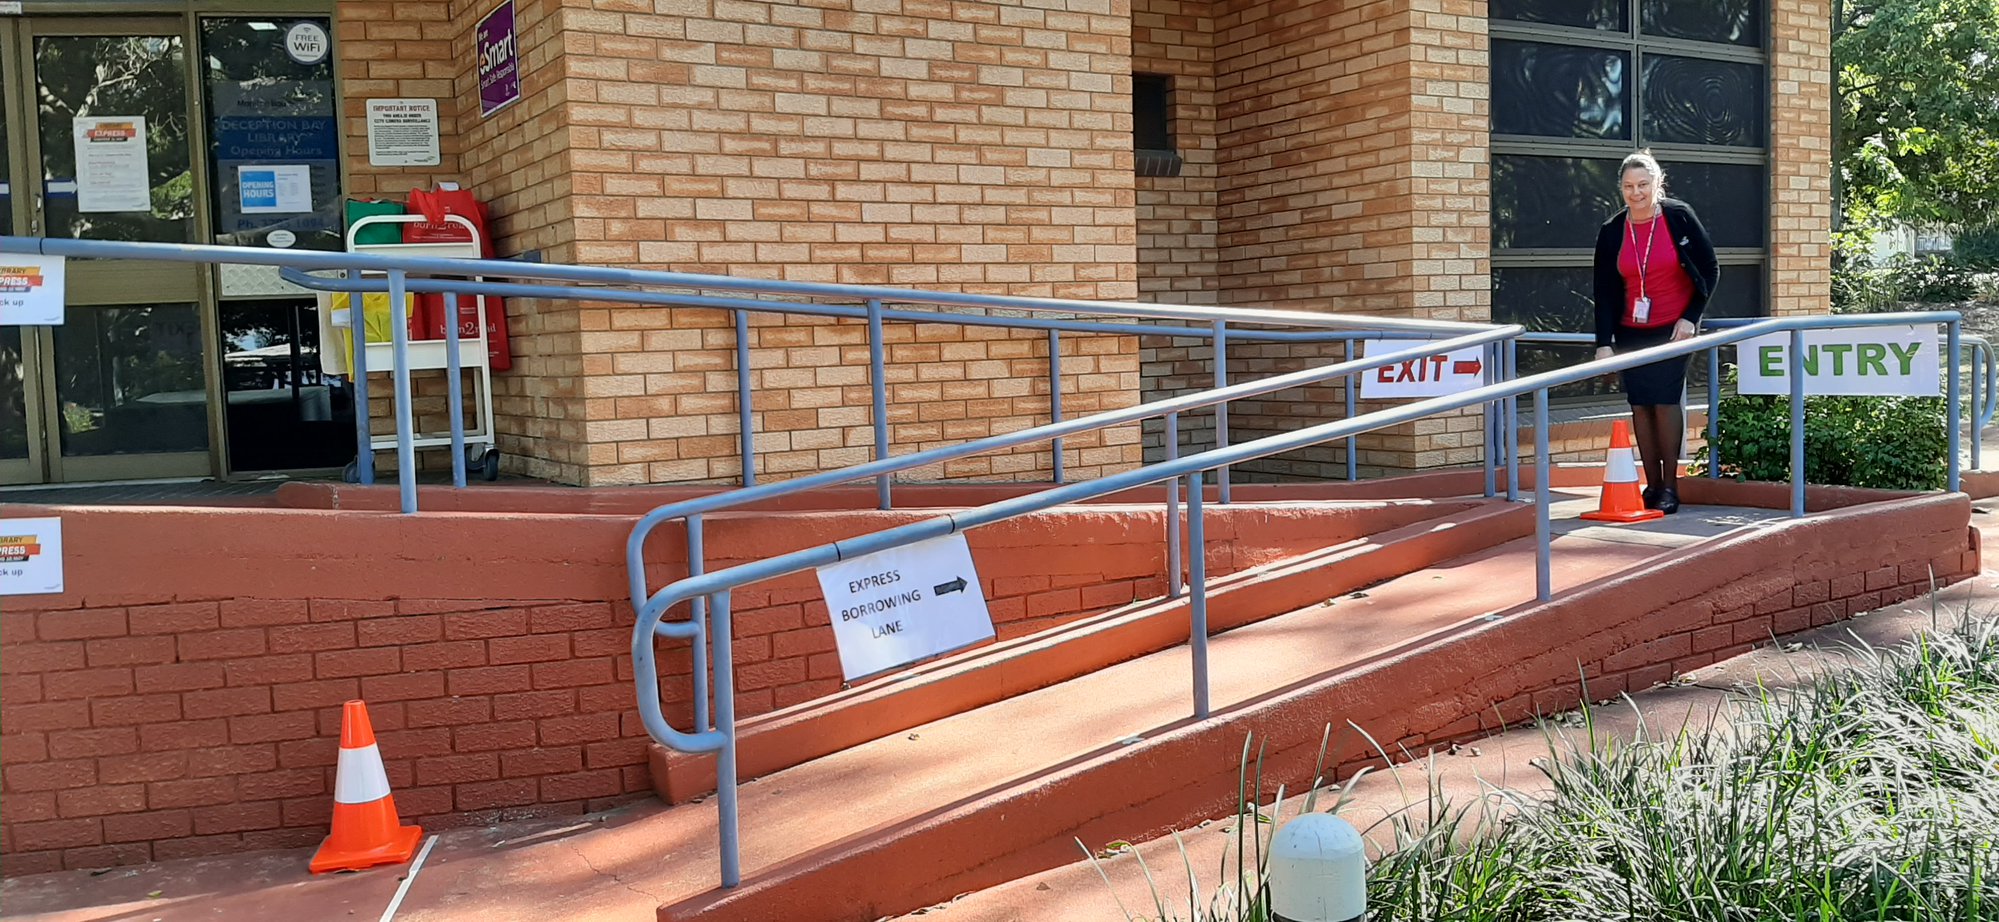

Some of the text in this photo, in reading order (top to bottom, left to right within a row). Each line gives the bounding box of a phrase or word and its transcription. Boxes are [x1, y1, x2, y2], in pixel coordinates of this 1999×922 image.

[293, 42, 321, 52] WiFi
[480, 28, 513, 75] eSmart
[221, 120, 327, 130] DECEPTION BAY
[247, 132, 301, 142] LIBRARY
[230, 144, 322, 157] Opening Hours
[242, 181, 274, 189] OPENING
[243, 189, 274, 198] HOURS
[1758, 342, 1922, 377] ENTRY
[1377, 355, 1448, 383] EXIT
[11, 569, 23, 577] up
[848, 569, 901, 594] EXPRESS
[841, 589, 922, 622] BORROWING
[871, 619, 904, 639] LANE
